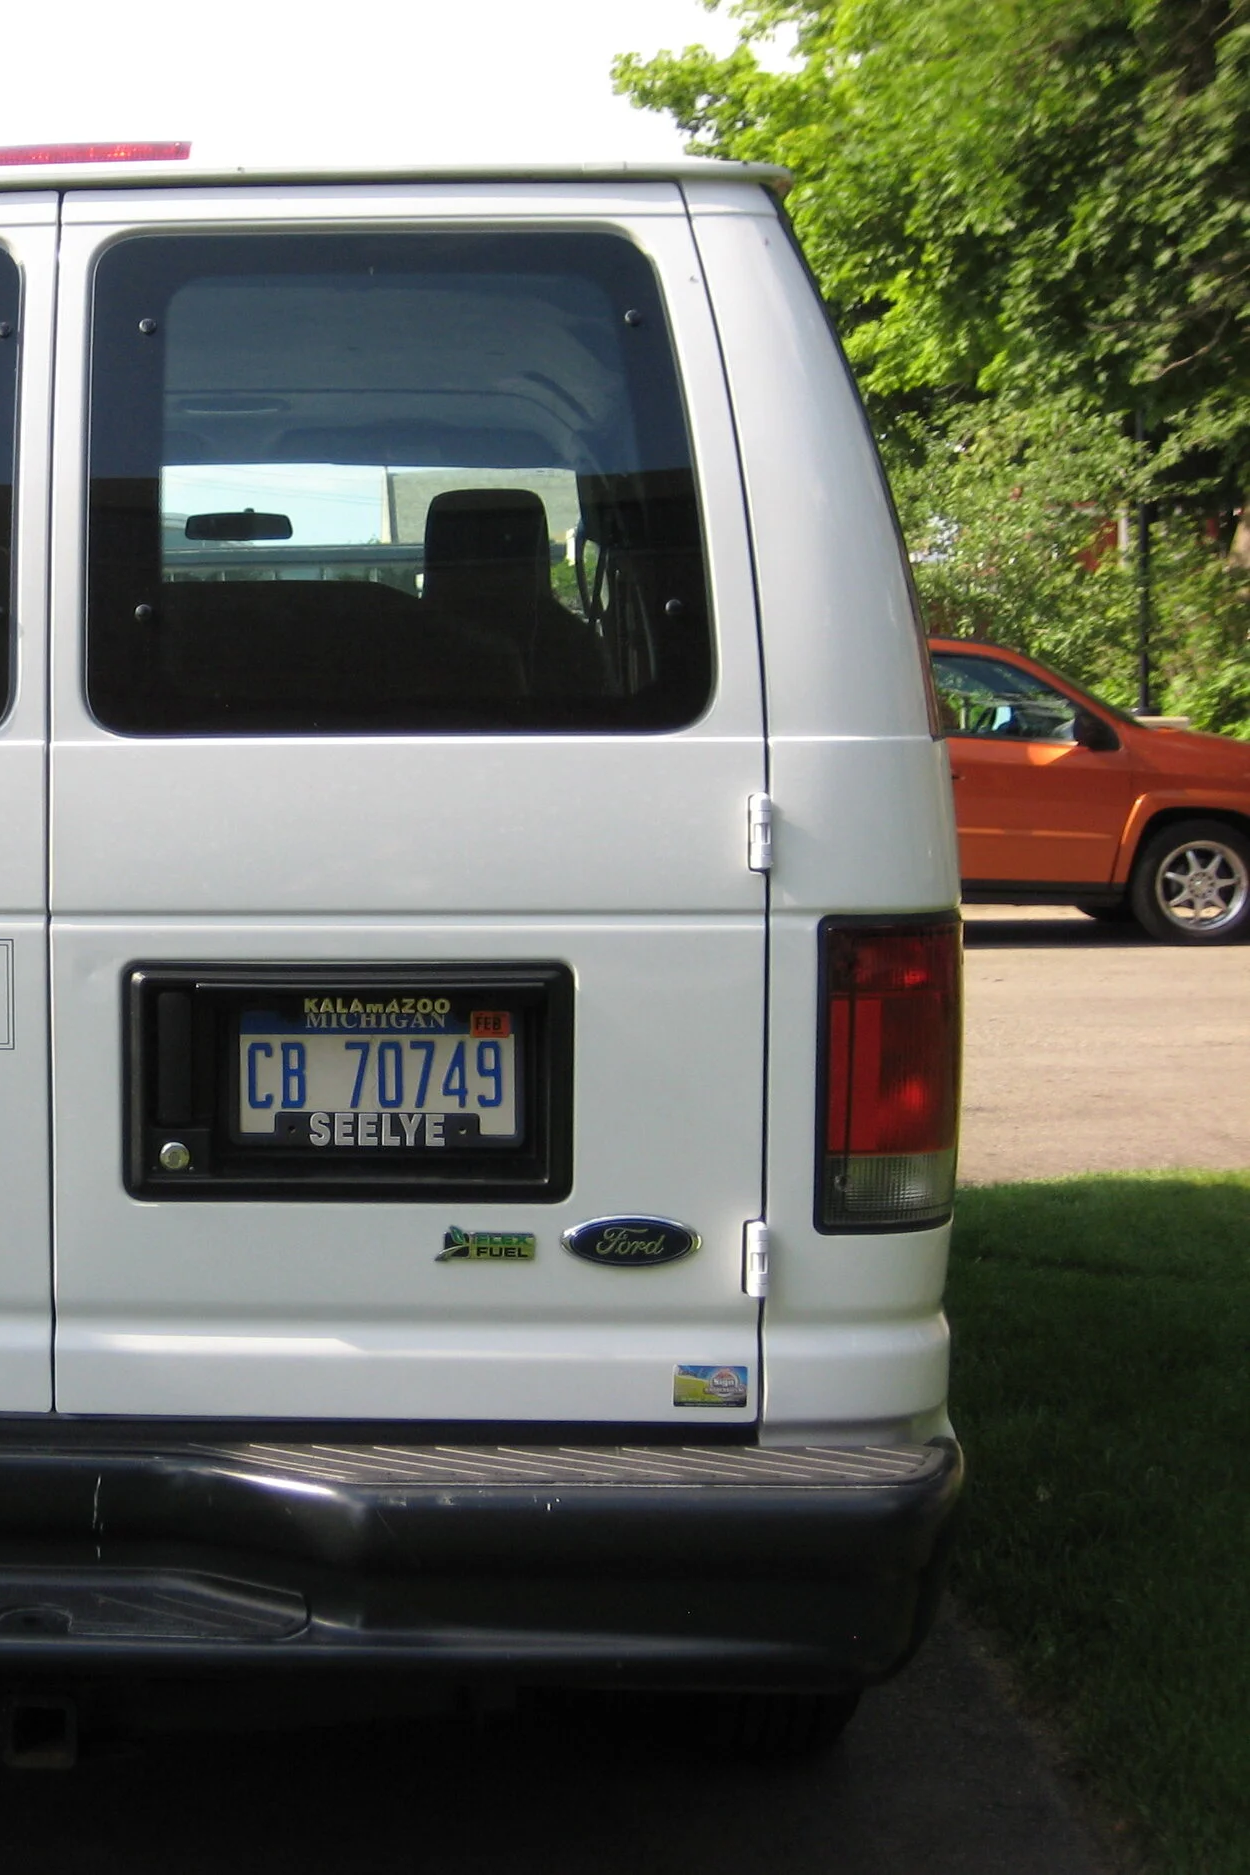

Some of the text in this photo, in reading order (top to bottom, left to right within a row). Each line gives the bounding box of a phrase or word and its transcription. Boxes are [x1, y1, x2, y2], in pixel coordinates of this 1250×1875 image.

[306, 1012, 445, 1029] MICHIGAN
[475, 1017, 501, 1031] FEB
[248, 1041, 502, 1108] CB 70749
[309, 1112, 446, 1147] SEELYE
[475, 1233, 530, 1245] FLEX
[596, 1226, 665, 1256] Ford
[476, 1246, 529, 1258] FUEL
